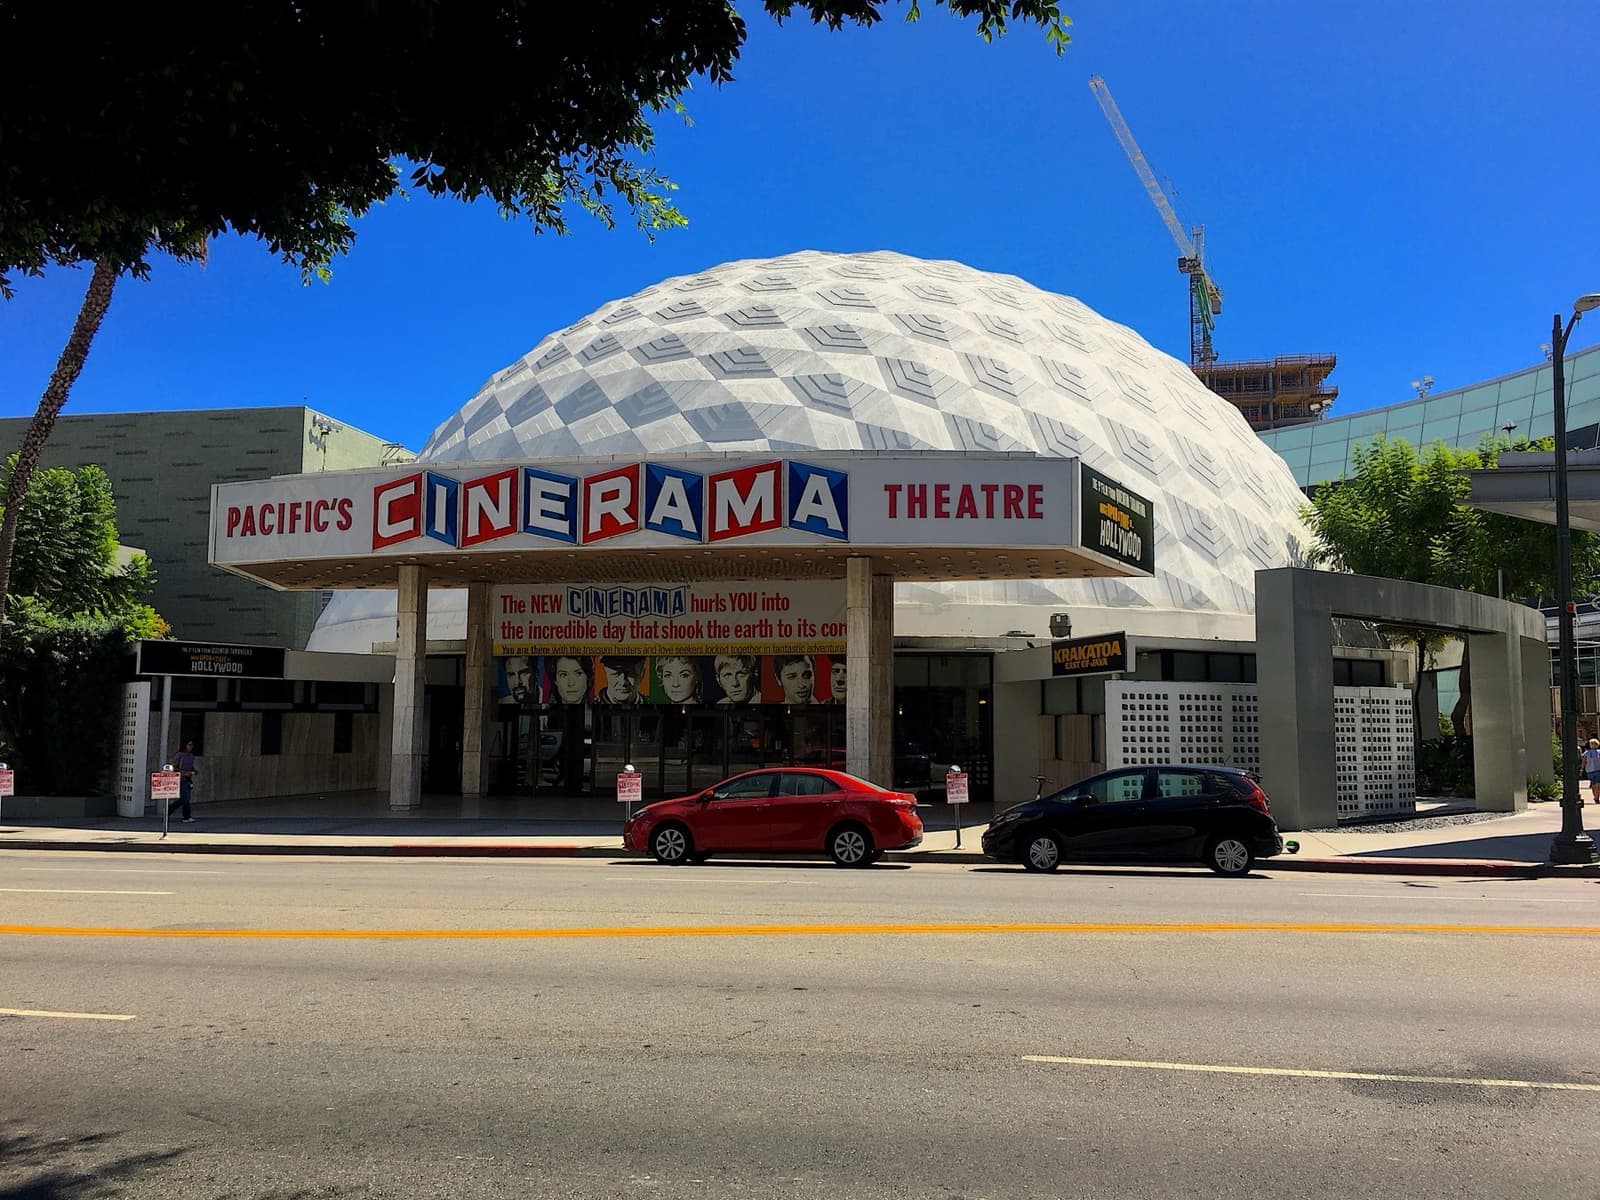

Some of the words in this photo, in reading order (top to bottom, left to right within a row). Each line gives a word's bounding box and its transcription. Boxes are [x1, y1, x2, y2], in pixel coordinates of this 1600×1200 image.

[226, 498, 353, 537] PACIFIC'S
[376, 469, 845, 539] CINERAMA
[884, 484, 1043, 519] THEATRE
[1100, 519, 1142, 561] HOLLYWOOD
[501, 595, 526, 613] The
[531, 595, 563, 613] NEW
[569, 590, 684, 614] CINERAMA
[691, 593, 727, 612] hurls
[728, 592, 757, 612] YOU
[761, 592, 790, 611] into
[501, 621, 523, 639] the
[529, 620, 597, 639] incredible
[603, 620, 626, 642] day
[630, 620, 659, 639] that
[662, 620, 703, 639] shook
[707, 619, 730, 638] the
[735, 619, 772, 638] earth
[777, 619, 792, 637] to
[798, 618, 816, 637] its
[821, 623, 847, 637] cor
[502, 645, 514, 655] You
[531, 645, 551, 655] there
[552, 645, 568, 655] with
[615, 644, 642, 654] hunters
[643, 644, 656, 654] and
[658, 644, 674, 654] love
[705, 644, 728, 654] locked
[731, 644, 761, 655] together
[772, 643, 803, 653] fantastic
[1054, 639, 1122, 664] KRAKATOA
[191, 661, 243, 673] HOLLYWOOD
[1065, 660, 1081, 670] EAST
[1081, 659, 1090, 668] OF
[1090, 657, 1108, 667] JAVA
